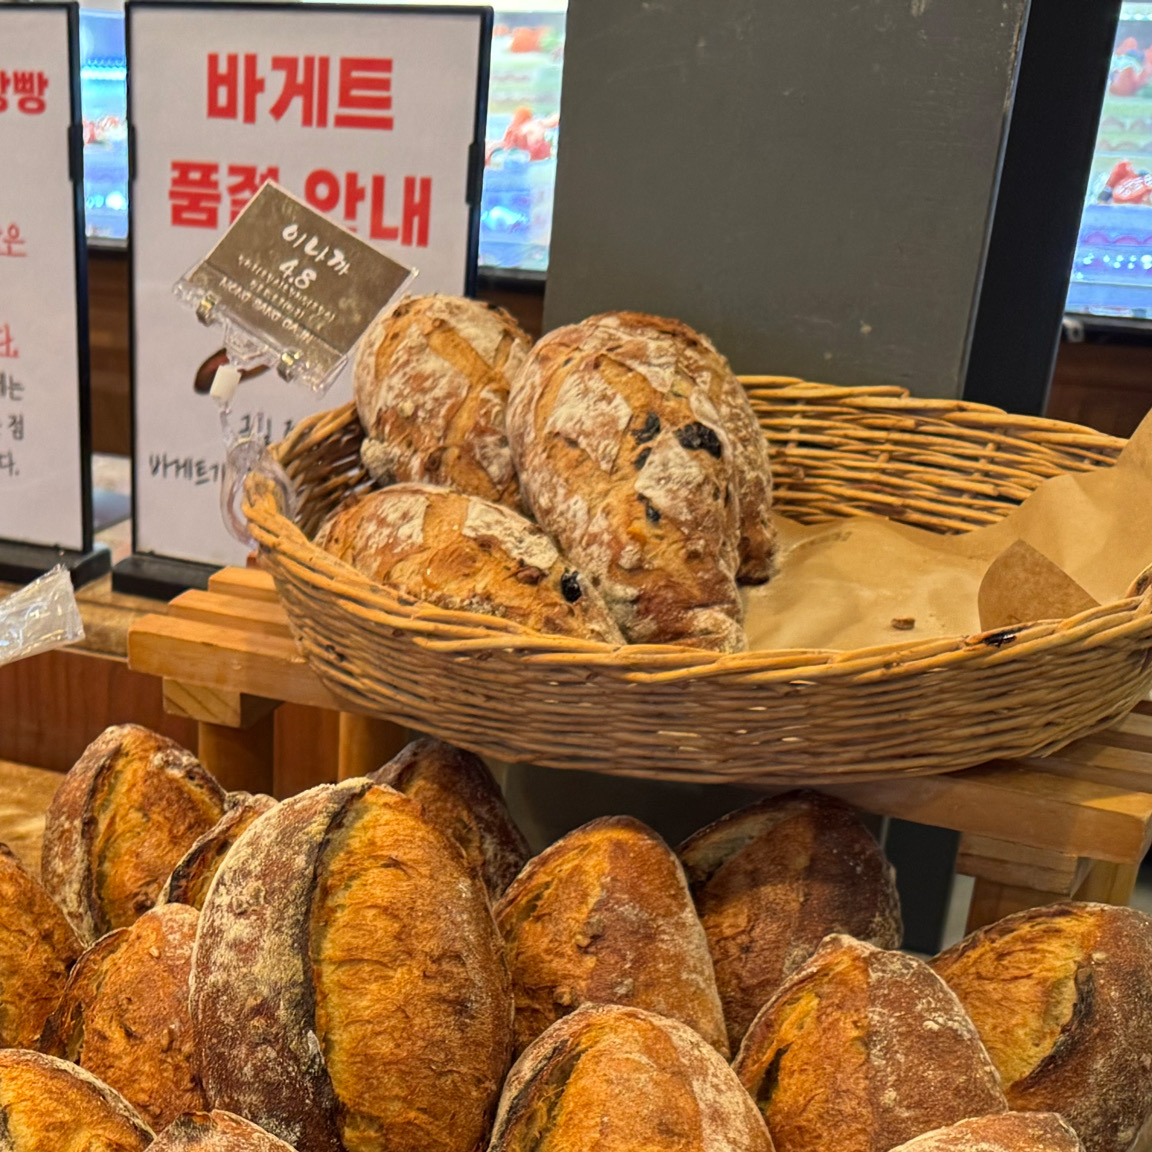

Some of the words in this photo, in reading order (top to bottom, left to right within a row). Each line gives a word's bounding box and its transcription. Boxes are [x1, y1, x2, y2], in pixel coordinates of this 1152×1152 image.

[206, 53, 394, 131] 바게트
[305, 168, 432, 248] 안내
[278, 259, 317, 289] 4.8
[7, 414, 25, 441] 점
